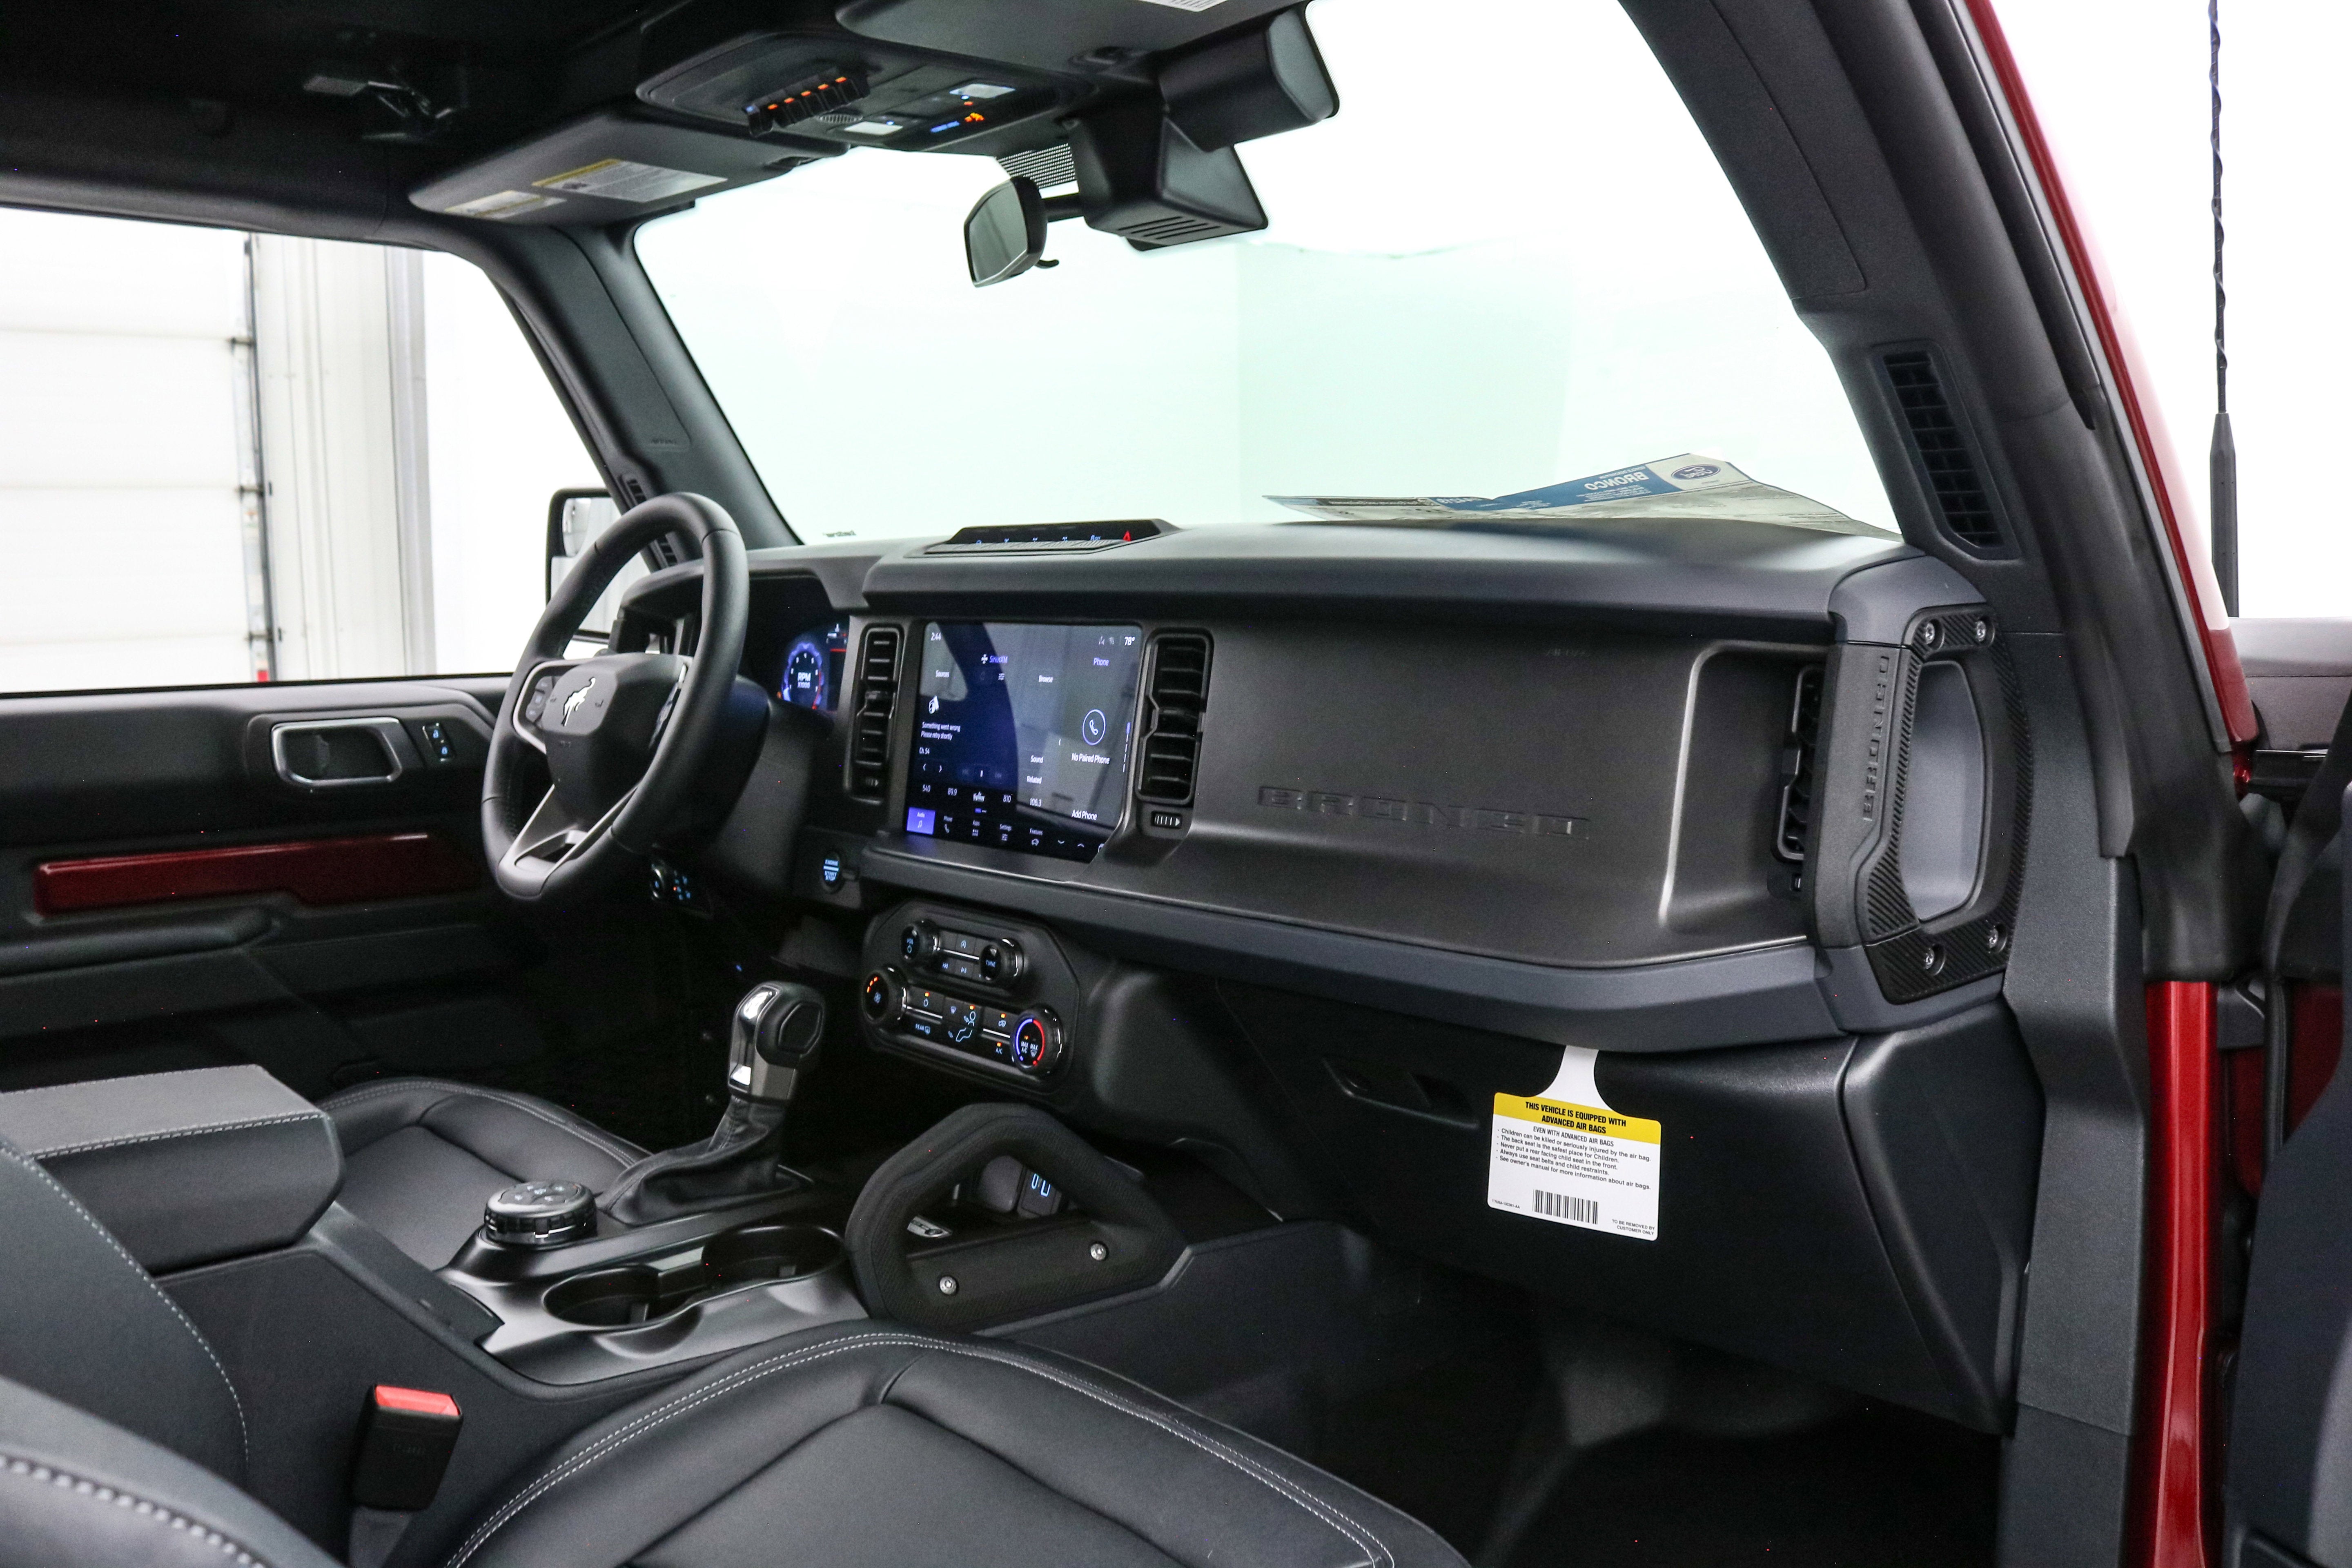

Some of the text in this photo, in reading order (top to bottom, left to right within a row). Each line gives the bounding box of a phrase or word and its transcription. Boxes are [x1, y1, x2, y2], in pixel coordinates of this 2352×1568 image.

[1093, 657, 1109, 666] Phone
[797, 672, 811, 682] RPM
[1862, 655, 1890, 822] BRONCO
[1031, 755, 1044, 763] Sound
[1071, 753, 1110, 764] No Paired Phone
[1026, 775, 1042, 784] Related
[947, 788, 958, 796] 89.9
[1003, 795, 1011, 803] 810
[1030, 798, 1042, 807] 106.3
[1071, 809, 1098, 821] Add Phone
[1258, 785, 1590, 840] BRONCO
[1526, 1101, 1539, 1111] THIS
[1541, 1104, 1566, 1116] VEHICLE
[1575, 1111, 1606, 1123] EQUIPPED
[1608, 1117, 1626, 1127] WITH
[1541, 1115, 1606, 1134] ADVANCED AIR BAGS
[1547, 1129, 1560, 1137] WITH
[1561, 1132, 1586, 1142] ADVANCED
[1501, 1128, 1522, 1137] Children
[1563, 1142, 1588, 1152] seriously
[1589, 1146, 1609, 1154] injured
[1639, 1154, 1651, 1163] bag.
[1501, 1134, 1510, 1143] The
[1594, 1152, 1619, 1163] Children.
[1501, 1141, 1515, 1149] Never
[1541, 1150, 1557, 1160] facing
[1500, 1149, 1518, 1158] Always
[1581, 1167, 1610, 1175] restraints.
[1575, 1172, 1607, 1182] information
